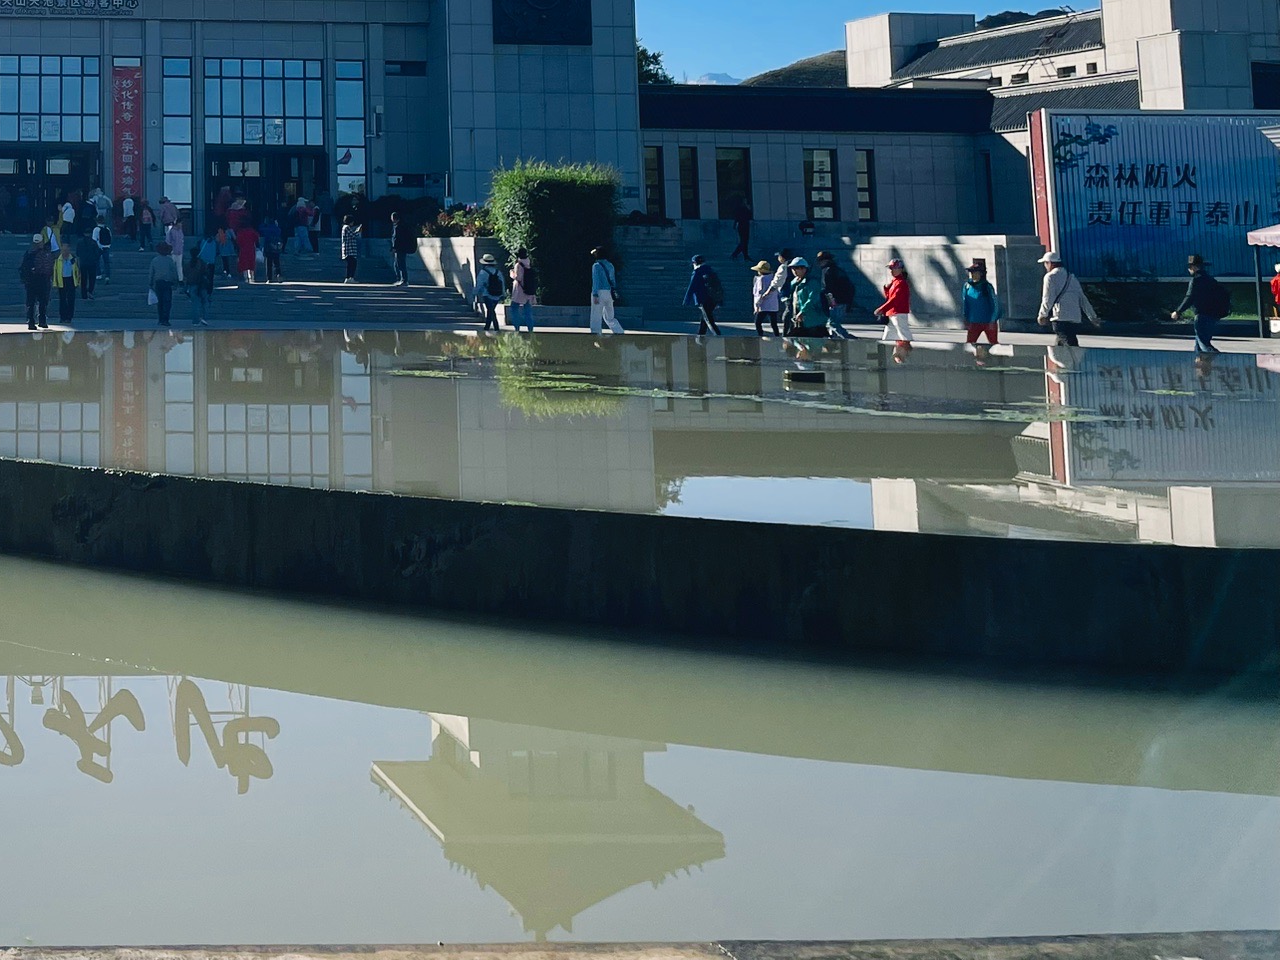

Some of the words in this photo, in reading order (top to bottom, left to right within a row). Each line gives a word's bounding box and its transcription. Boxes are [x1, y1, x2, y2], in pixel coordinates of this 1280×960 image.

[1083, 163, 1197, 189] 森林防火
[1087, 200, 1259, 227] 责任重于泰山
